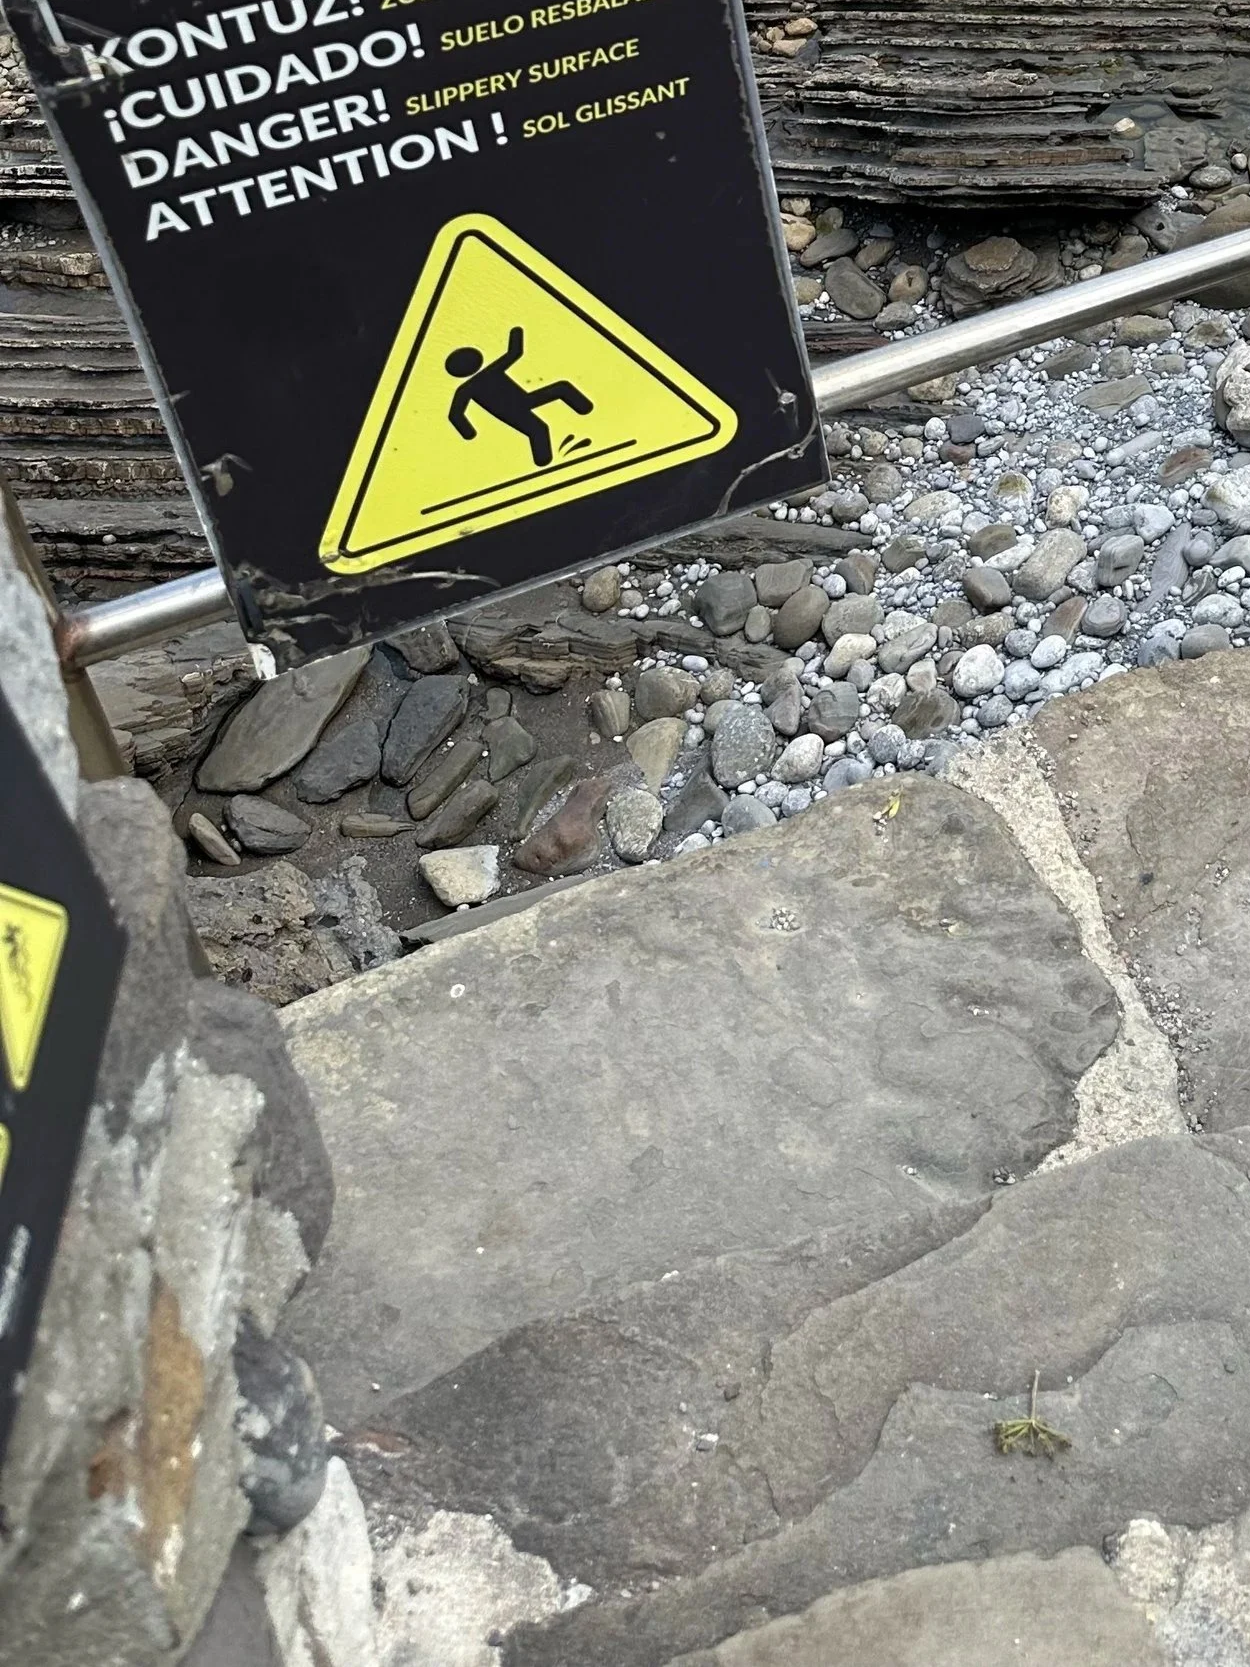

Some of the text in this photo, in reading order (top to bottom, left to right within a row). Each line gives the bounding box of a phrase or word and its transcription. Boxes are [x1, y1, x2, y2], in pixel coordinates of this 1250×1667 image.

[103, 22, 427, 143] ¡CUIDADO!
[440, 15, 525, 51] SUELO
[120, 38, 640, 189] DANGER! SLIPPERY SURFACE
[146, 119, 480, 242] ATTENTION
[523, 112, 570, 138] SOL
[575, 77, 691, 123] GLISSANT
